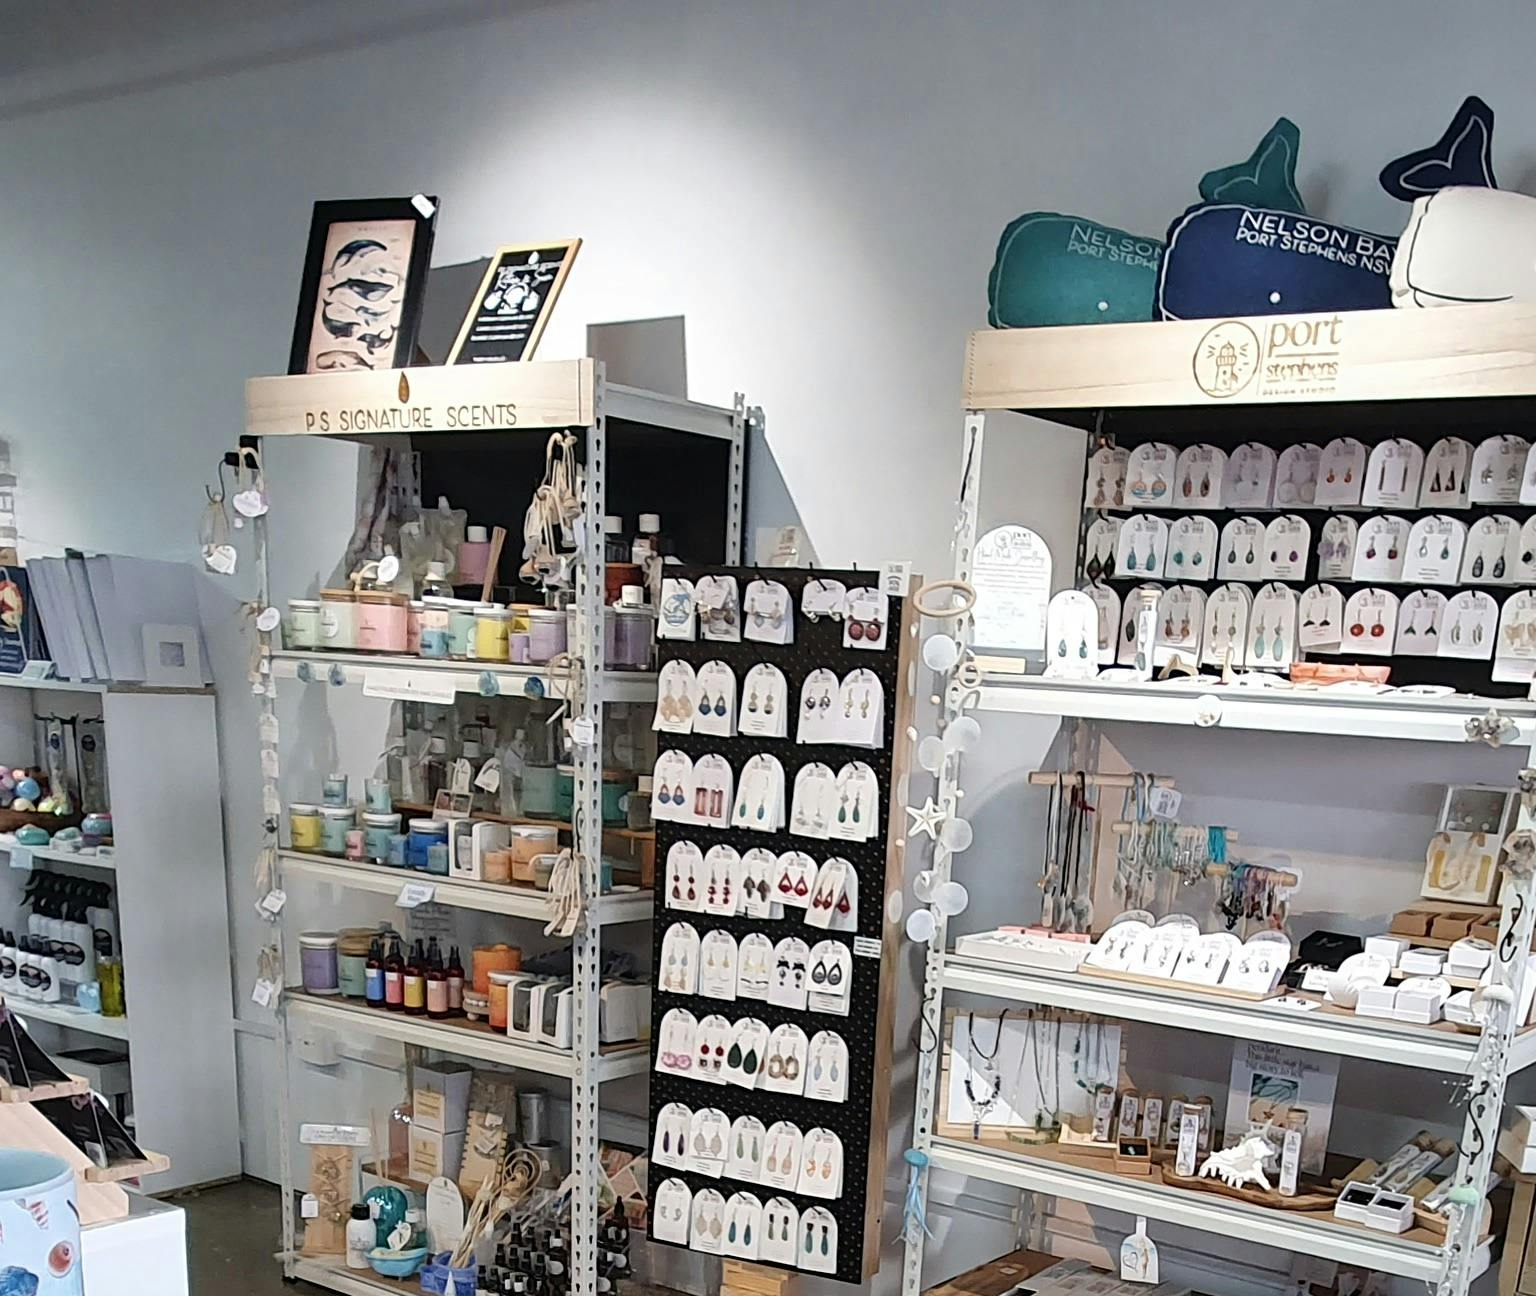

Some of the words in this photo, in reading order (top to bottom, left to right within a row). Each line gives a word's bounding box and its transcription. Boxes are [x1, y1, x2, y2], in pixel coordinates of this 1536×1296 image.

[1066, 240, 1105, 259] PORT
[1235, 227, 1277, 247] PORT
[1280, 234, 1357, 267] STEPHENS
[1239, 210, 1349, 249] NELSON
[1356, 235, 1398, 262] BA
[1267, 315, 1343, 358] port
[1265, 358, 1339, 380] stephens
[305, 411, 315, 432] P
[320, 411, 330, 432] S
[339, 407, 433, 431] SIGNATURE
[446, 403, 518, 428] SCENTS
